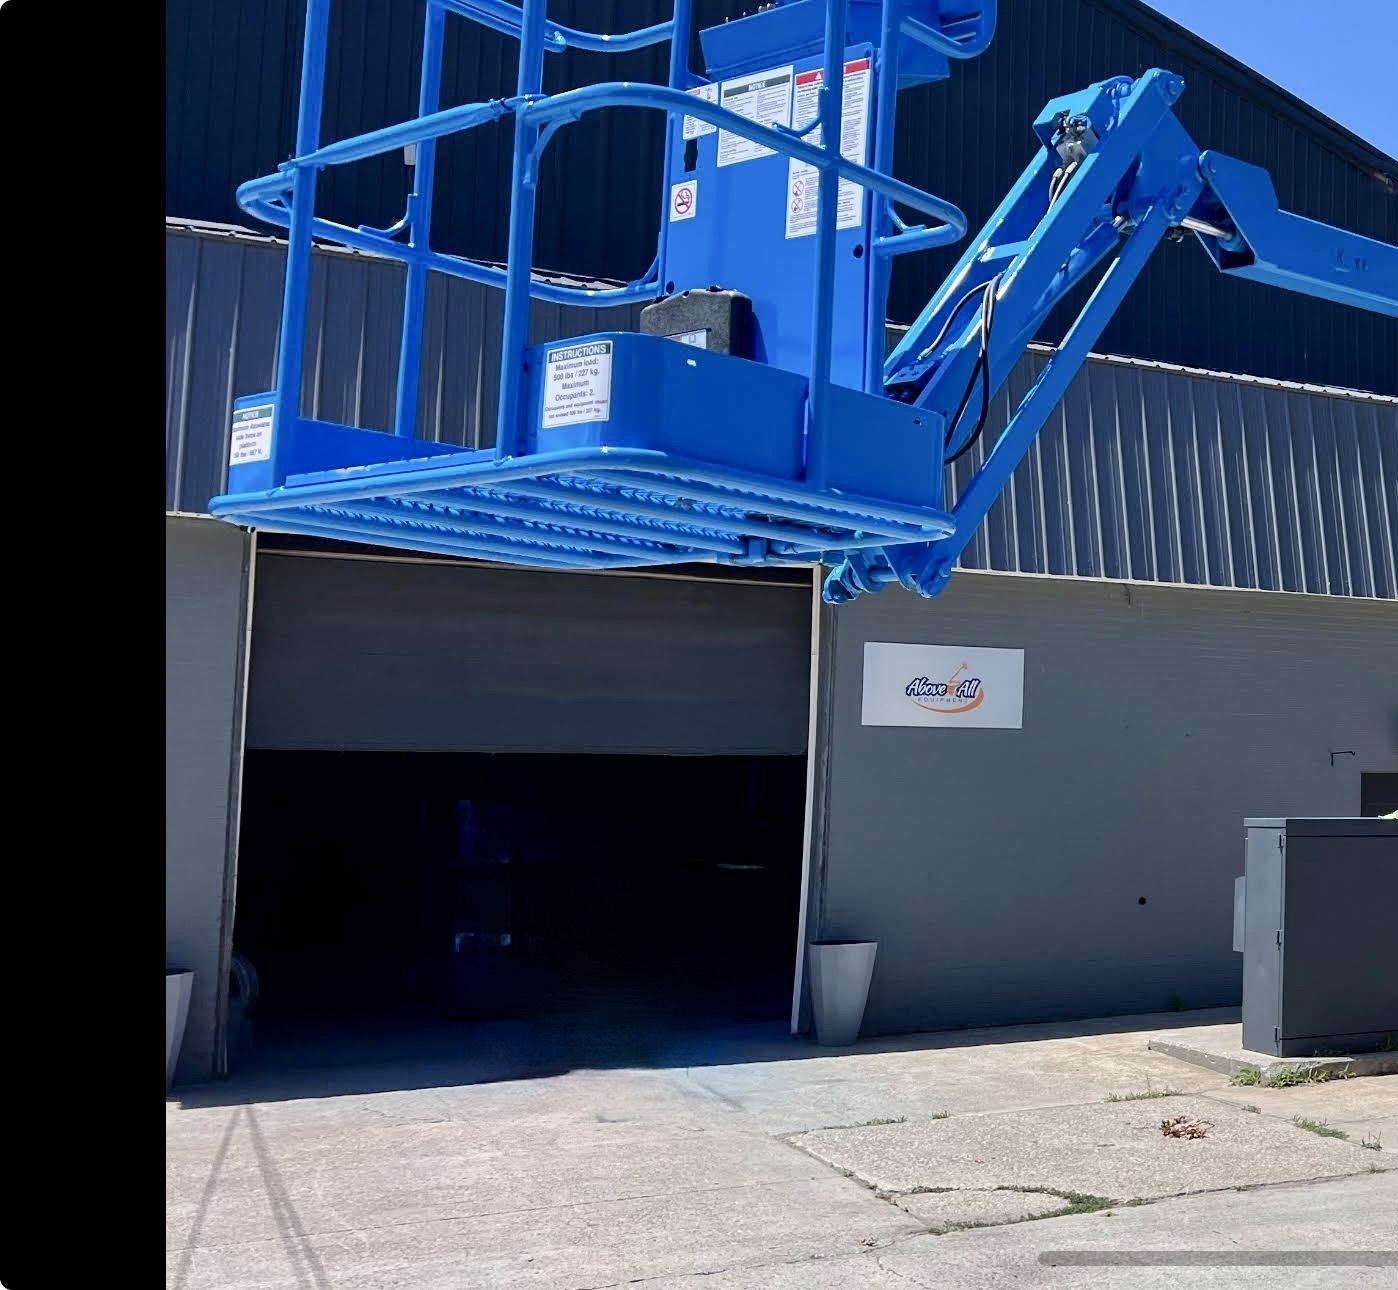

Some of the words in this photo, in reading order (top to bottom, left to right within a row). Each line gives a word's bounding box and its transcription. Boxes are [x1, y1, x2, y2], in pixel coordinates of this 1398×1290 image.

[551, 345, 606, 361] INSTRUCTIONS
[556, 361, 583, 371] Maximum
[584, 359, 599, 367] load:
[565, 370, 574, 378] lbs
[578, 369, 588, 377] 227
[562, 380, 589, 389] Maximum
[555, 392, 588, 401] Occupants:
[906, 676, 947, 697] Above
[956, 678, 981, 698] All
[917, 696, 968, 704] EQUIPMENT
